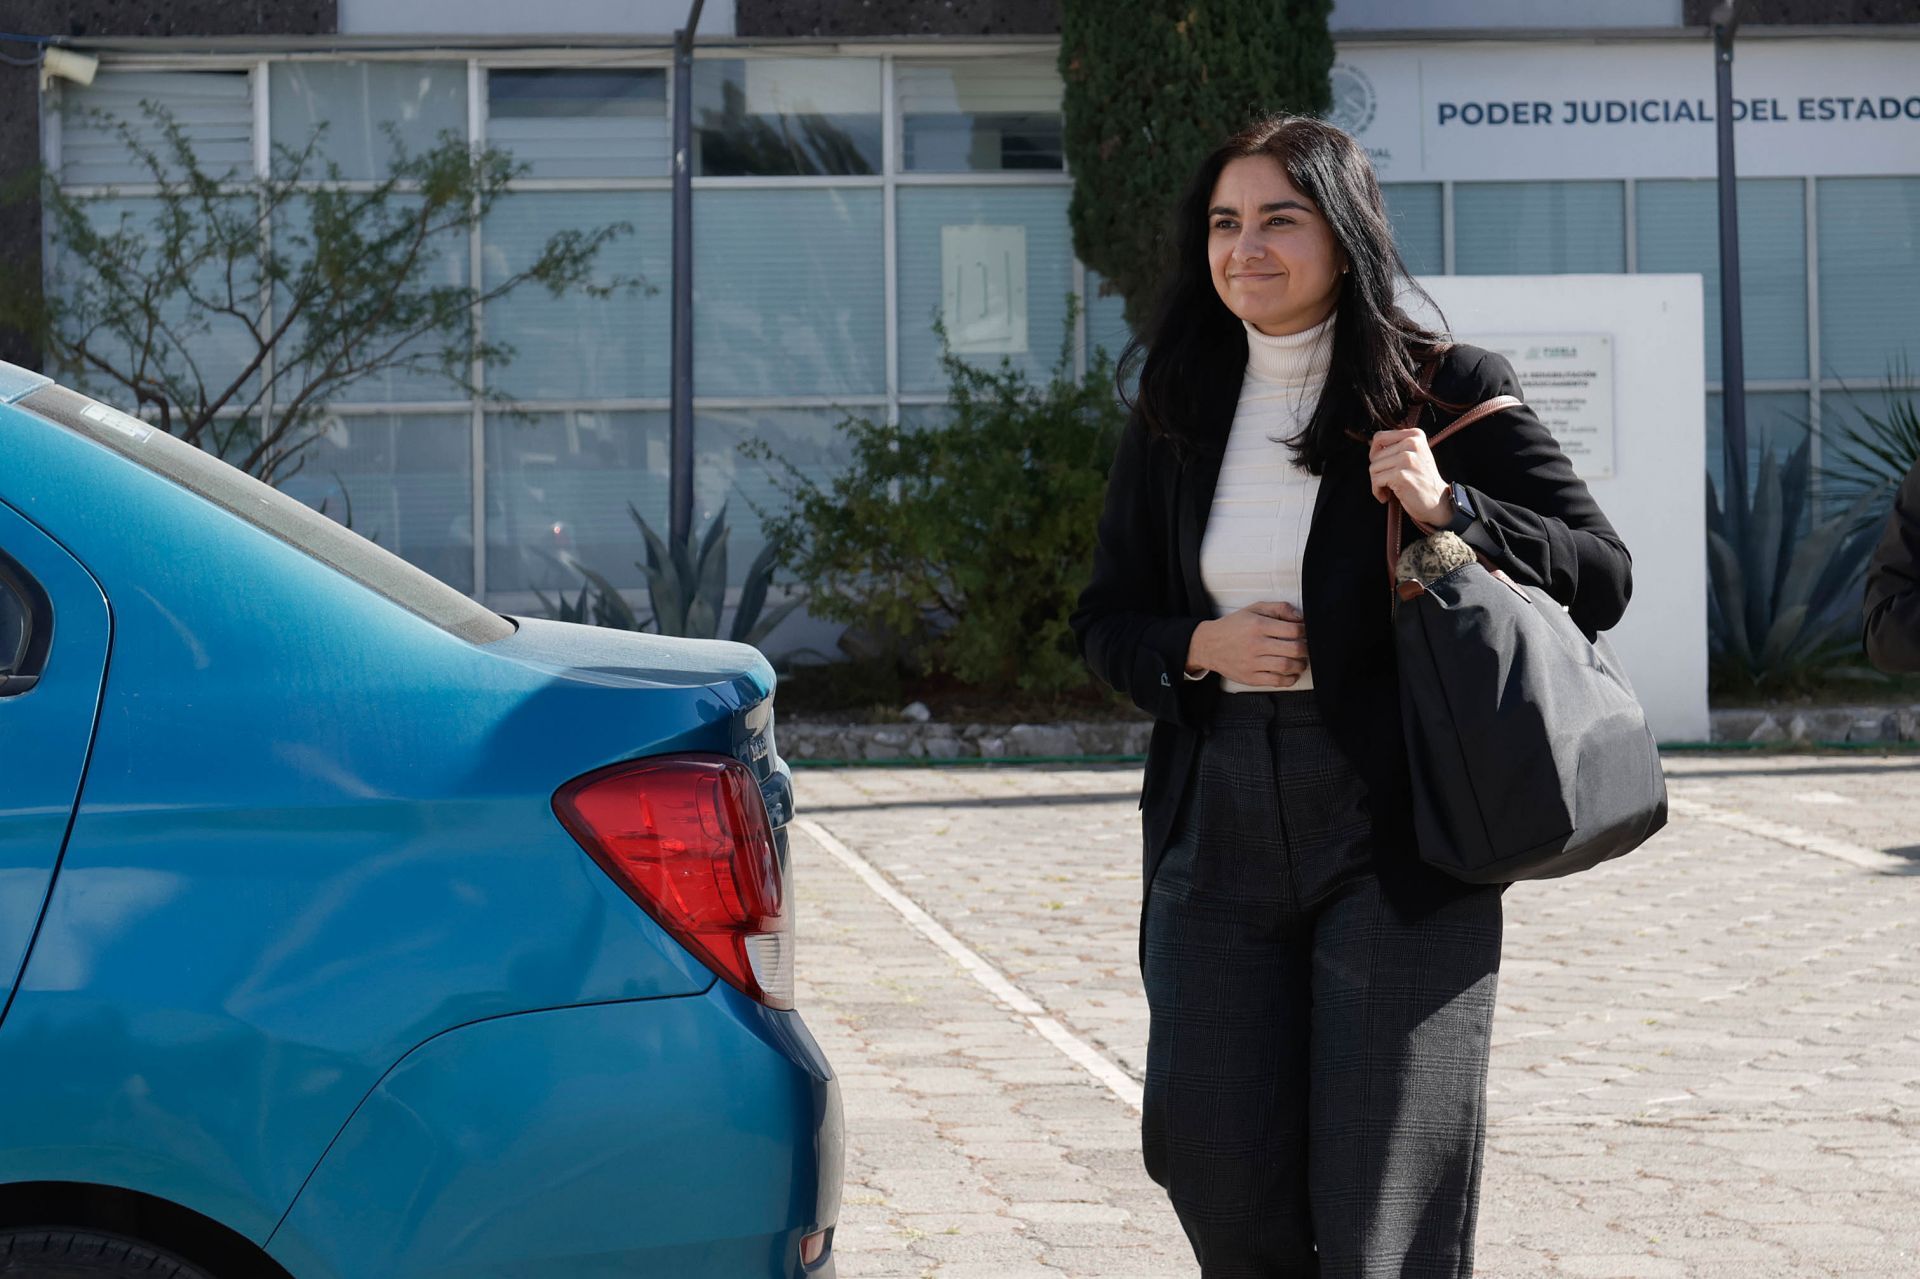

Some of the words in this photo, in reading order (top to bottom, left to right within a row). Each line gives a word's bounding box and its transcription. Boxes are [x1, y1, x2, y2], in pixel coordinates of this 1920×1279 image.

[1438, 102, 1552, 125] PODER
[1562, 99, 1714, 124] JUDICIAL
[1797, 96, 1920, 120] ESTADO
